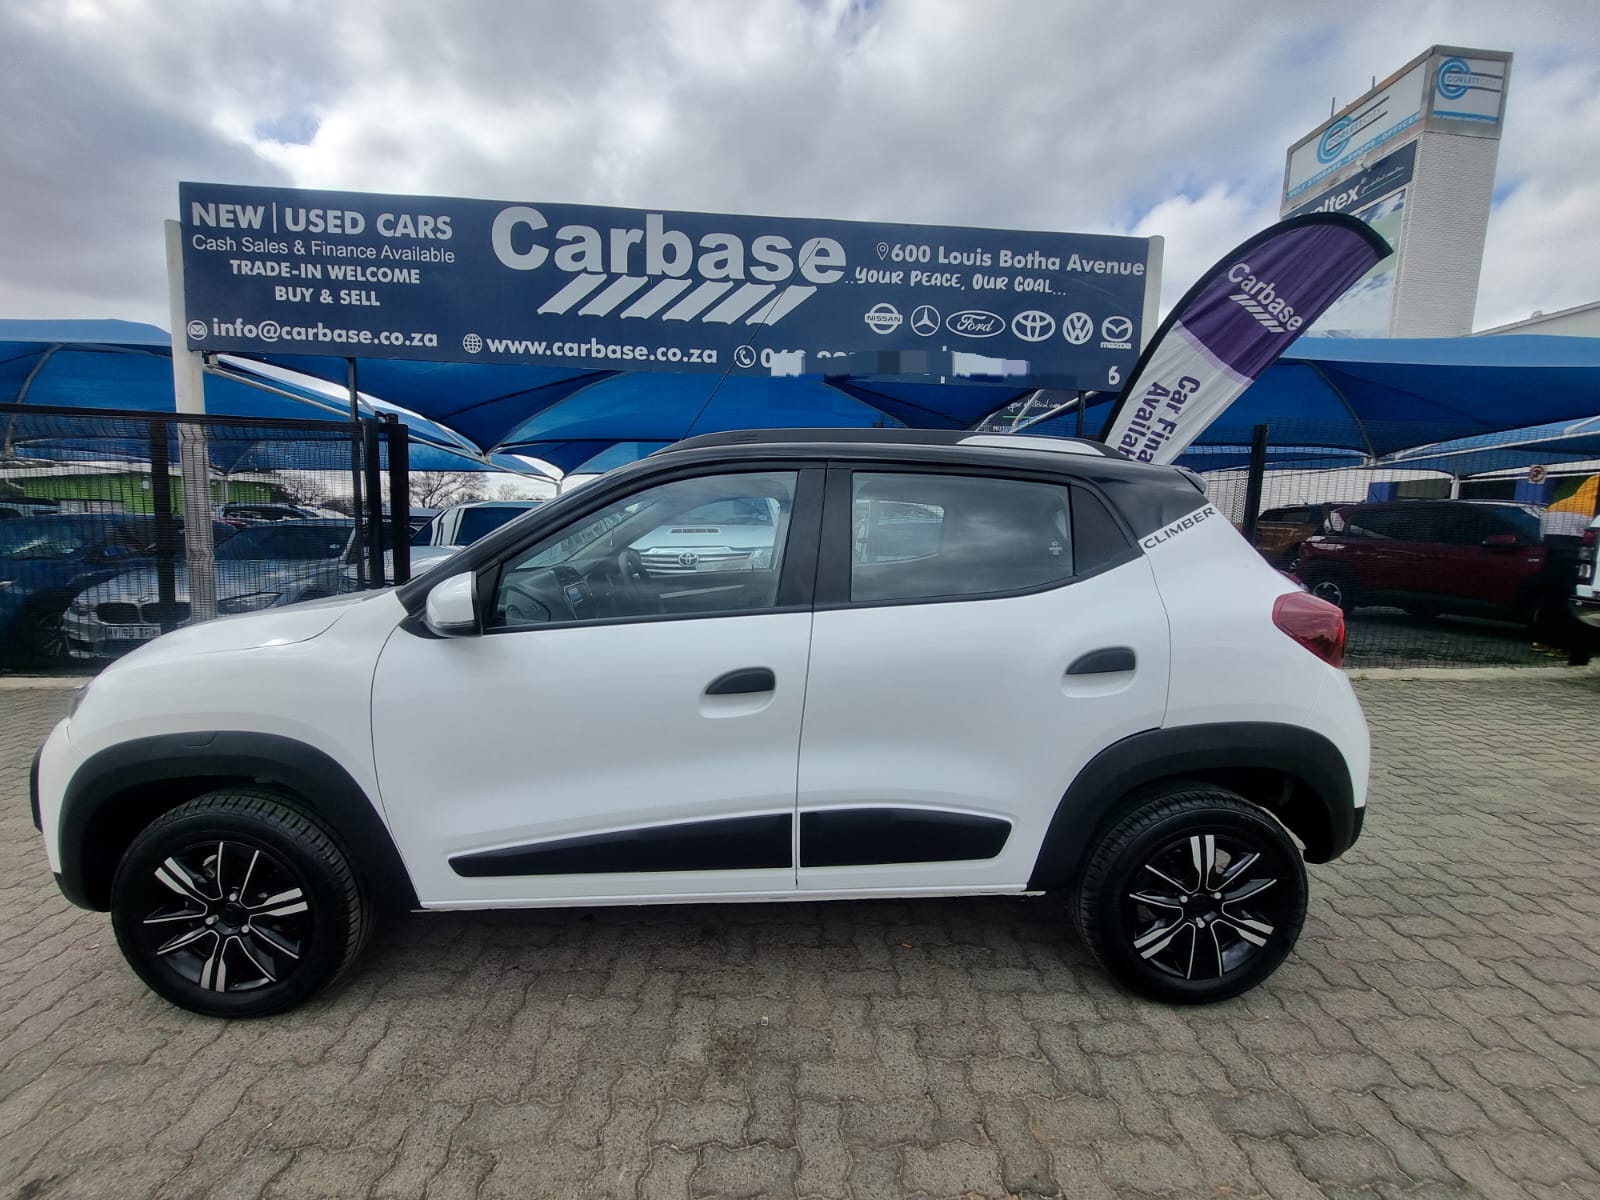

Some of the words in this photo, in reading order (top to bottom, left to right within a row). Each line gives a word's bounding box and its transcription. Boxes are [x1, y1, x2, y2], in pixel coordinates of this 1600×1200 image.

[191, 201, 265, 230] NEW
[284, 207, 366, 235] USED
[376, 213, 453, 240] CARS
[192, 234, 236, 252] Cash
[242, 236, 289, 255] Sales
[293, 239, 307, 256] &
[311, 240, 377, 259] Finance
[380, 244, 456, 264] Available
[491, 205, 847, 285] Carbase
[891, 243, 931, 263] 600
[938, 246, 993, 267] Louis
[999, 250, 1061, 271] Botha
[1066, 254, 1145, 276] Avenue
[230, 260, 321, 279] TRADE-IN
[328, 265, 420, 284] WELCOME
[910, 270, 965, 290] PEACE,
[972, 273, 1009, 290] OUR
[275, 286, 314, 304] BUY
[319, 289, 334, 304] &
[339, 290, 380, 307] SELL
[1227, 262, 1304, 332] Carbase
[211, 317, 438, 348] info@carbase.co.za
[867, 314, 901, 323] NISSAN
[957, 314, 996, 333] Ford
[486, 337, 718, 365] www.carbase.co.za
[1166, 375, 1201, 415] Car
[1143, 506, 1216, 549] CLIMBER
